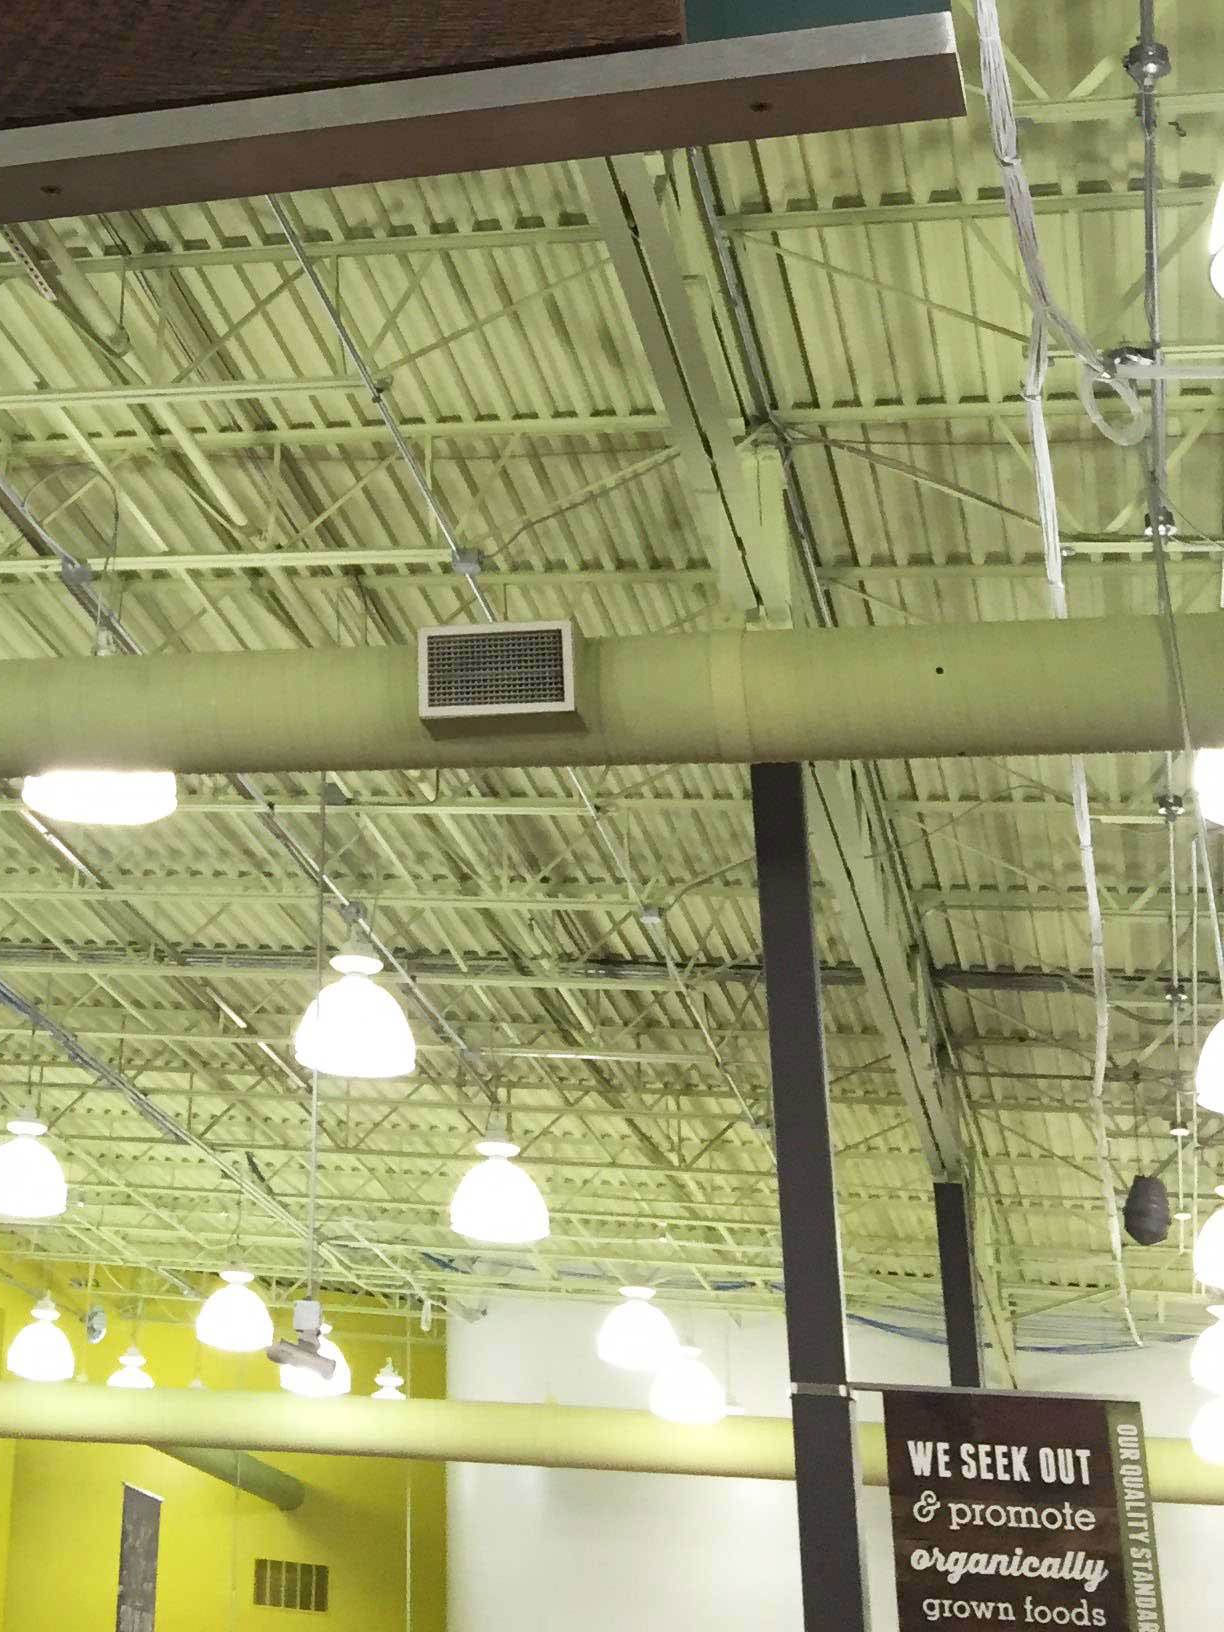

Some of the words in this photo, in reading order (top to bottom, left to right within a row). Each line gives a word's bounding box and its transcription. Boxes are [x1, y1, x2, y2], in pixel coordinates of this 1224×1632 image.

[907, 1440, 952, 1478] WE
[961, 1442, 1031, 1483] SEEK
[1040, 1447, 1091, 1485] OUT
[1116, 1424, 1140, 1460] OUR
[912, 1490, 940, 1523] &
[948, 1500, 1096, 1532] promote
[1119, 1464, 1150, 1544] QUALITY
[910, 1547, 1109, 1593] organically
[922, 1596, 1015, 1623] grown
[1024, 1596, 1107, 1627] foods
